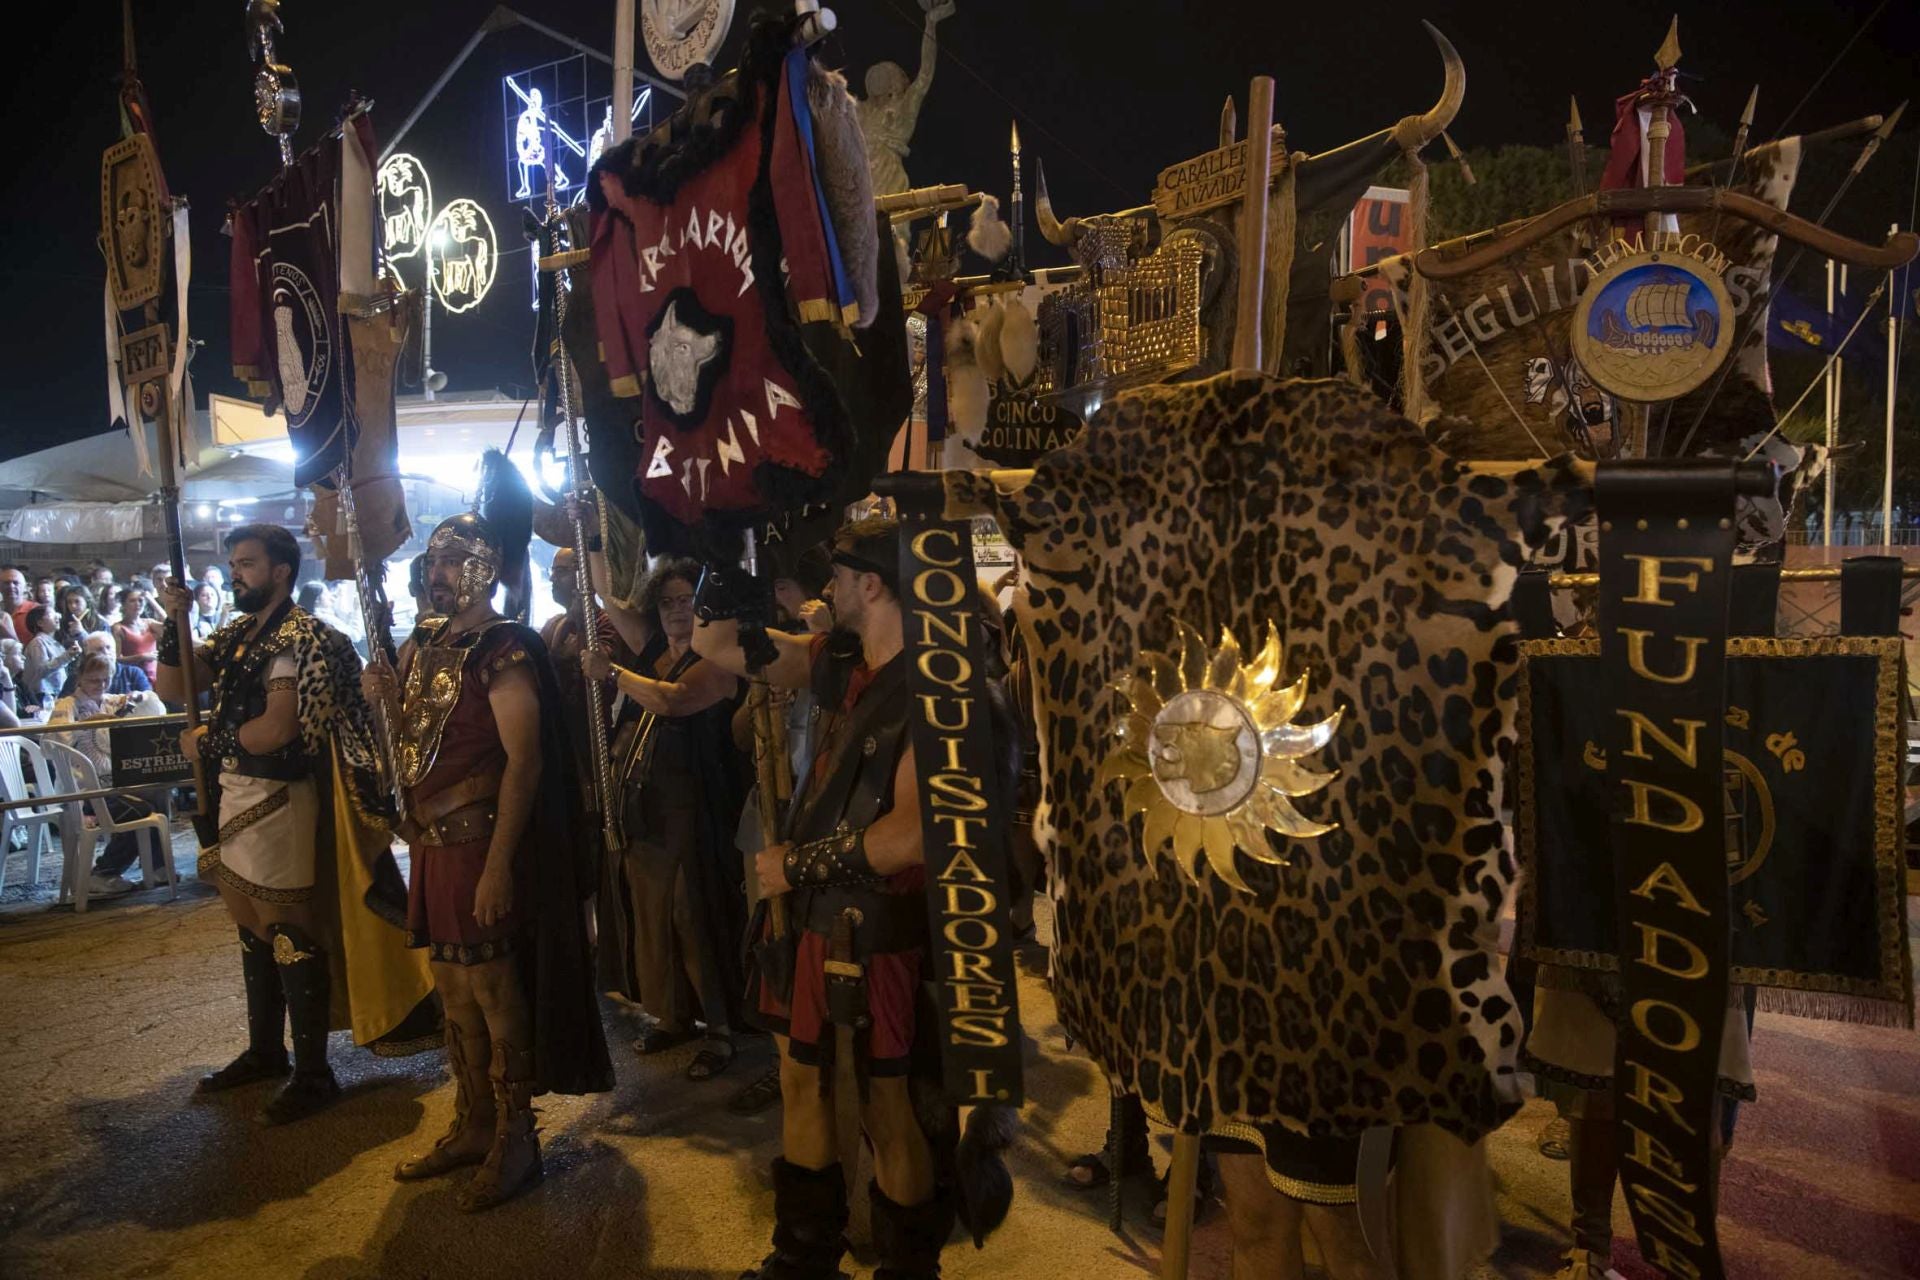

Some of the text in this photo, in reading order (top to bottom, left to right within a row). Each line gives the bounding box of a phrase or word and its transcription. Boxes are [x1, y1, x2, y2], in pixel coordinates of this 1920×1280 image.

[1583, 230, 1734, 277] HIMILCON
[997, 401, 1056, 424] CINCO
[911, 529, 1008, 1047] CONQUISTADORES
[1615, 553, 1714, 1248] FUNDADORES
